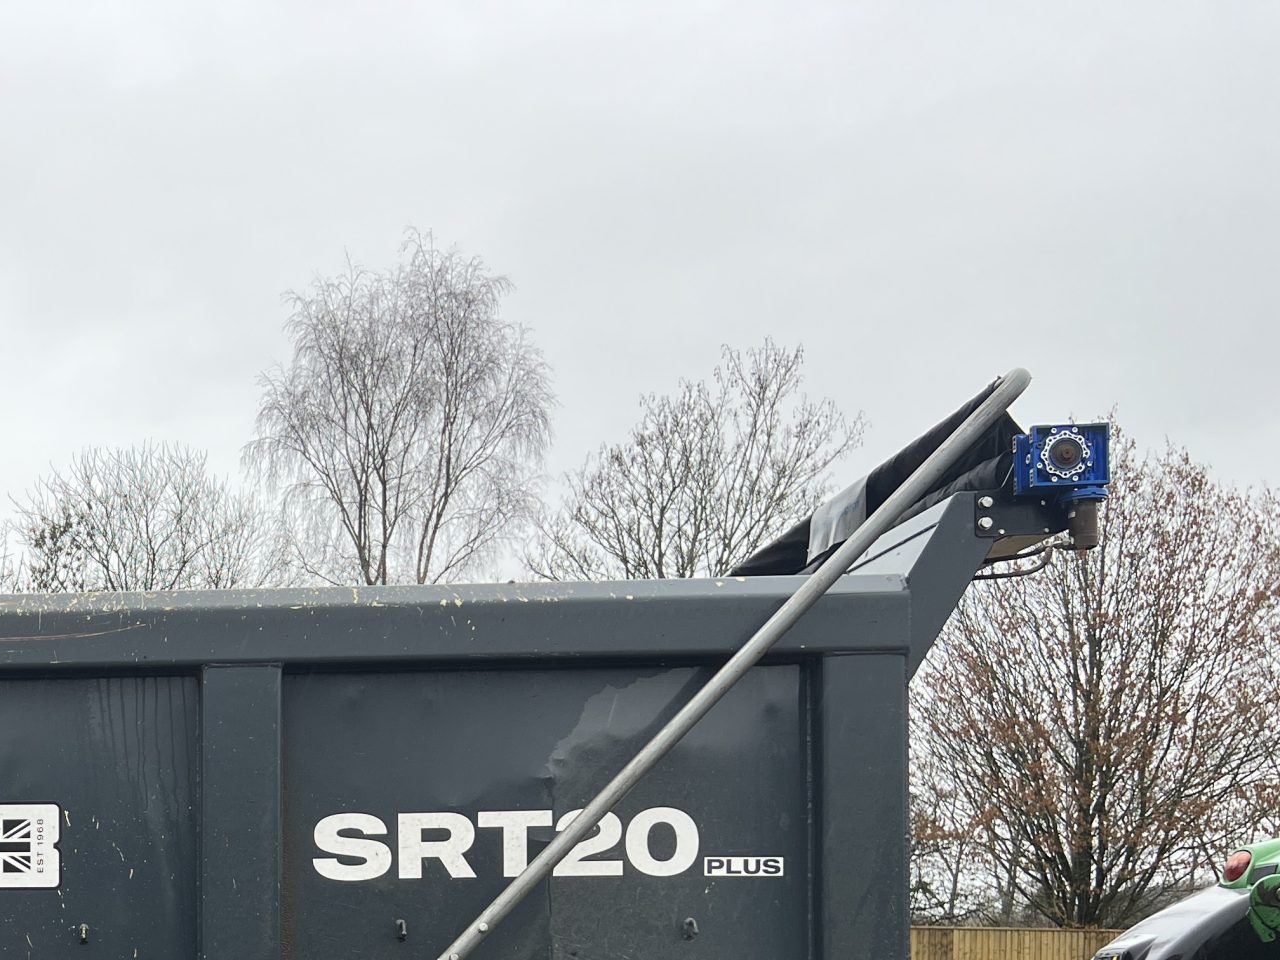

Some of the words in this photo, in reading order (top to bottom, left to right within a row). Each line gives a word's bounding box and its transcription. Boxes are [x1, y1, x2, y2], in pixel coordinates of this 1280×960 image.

[36, 818, 44, 846] 1968
[312, 806, 700, 882] SRT20
[707, 859, 781, 874] PLUS
[36, 851, 44, 873] EST
